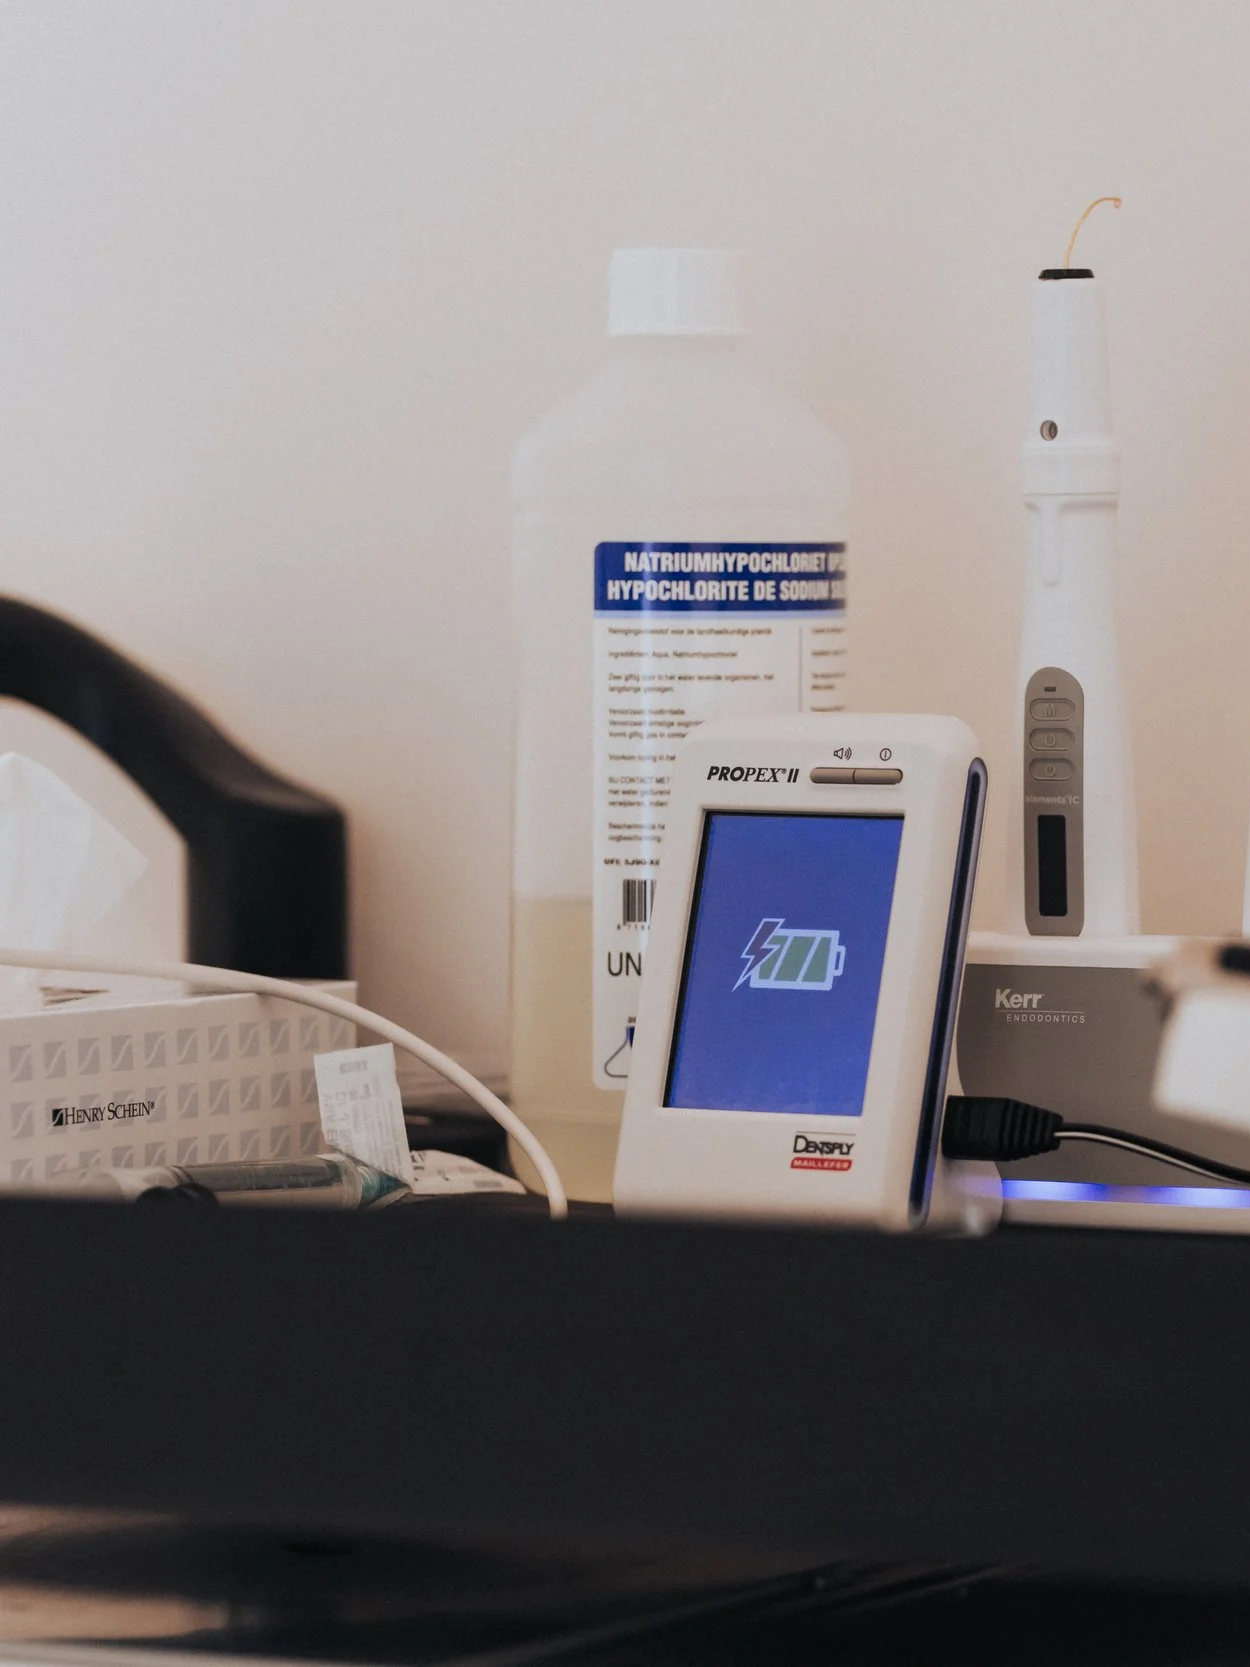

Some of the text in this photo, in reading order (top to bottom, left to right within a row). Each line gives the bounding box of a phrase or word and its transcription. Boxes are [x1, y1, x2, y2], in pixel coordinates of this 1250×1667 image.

[624, 551, 826, 573] NATRIUMHYPOCHLORIET
[607, 579, 749, 601] HYPOCHLORITE
[753, 579, 776, 601] DE
[779, 579, 829, 601] SODIUM
[786, 768, 799, 783] II
[607, 951, 642, 977] UN
[995, 988, 1043, 1009] Kerr
[1006, 1013, 1086, 1024] ENDODONTICS
[64, 1107, 107, 1126] HENRY
[793, 1135, 854, 1154] DENTSPLY
[793, 1159, 849, 1169] MAILLEFER
